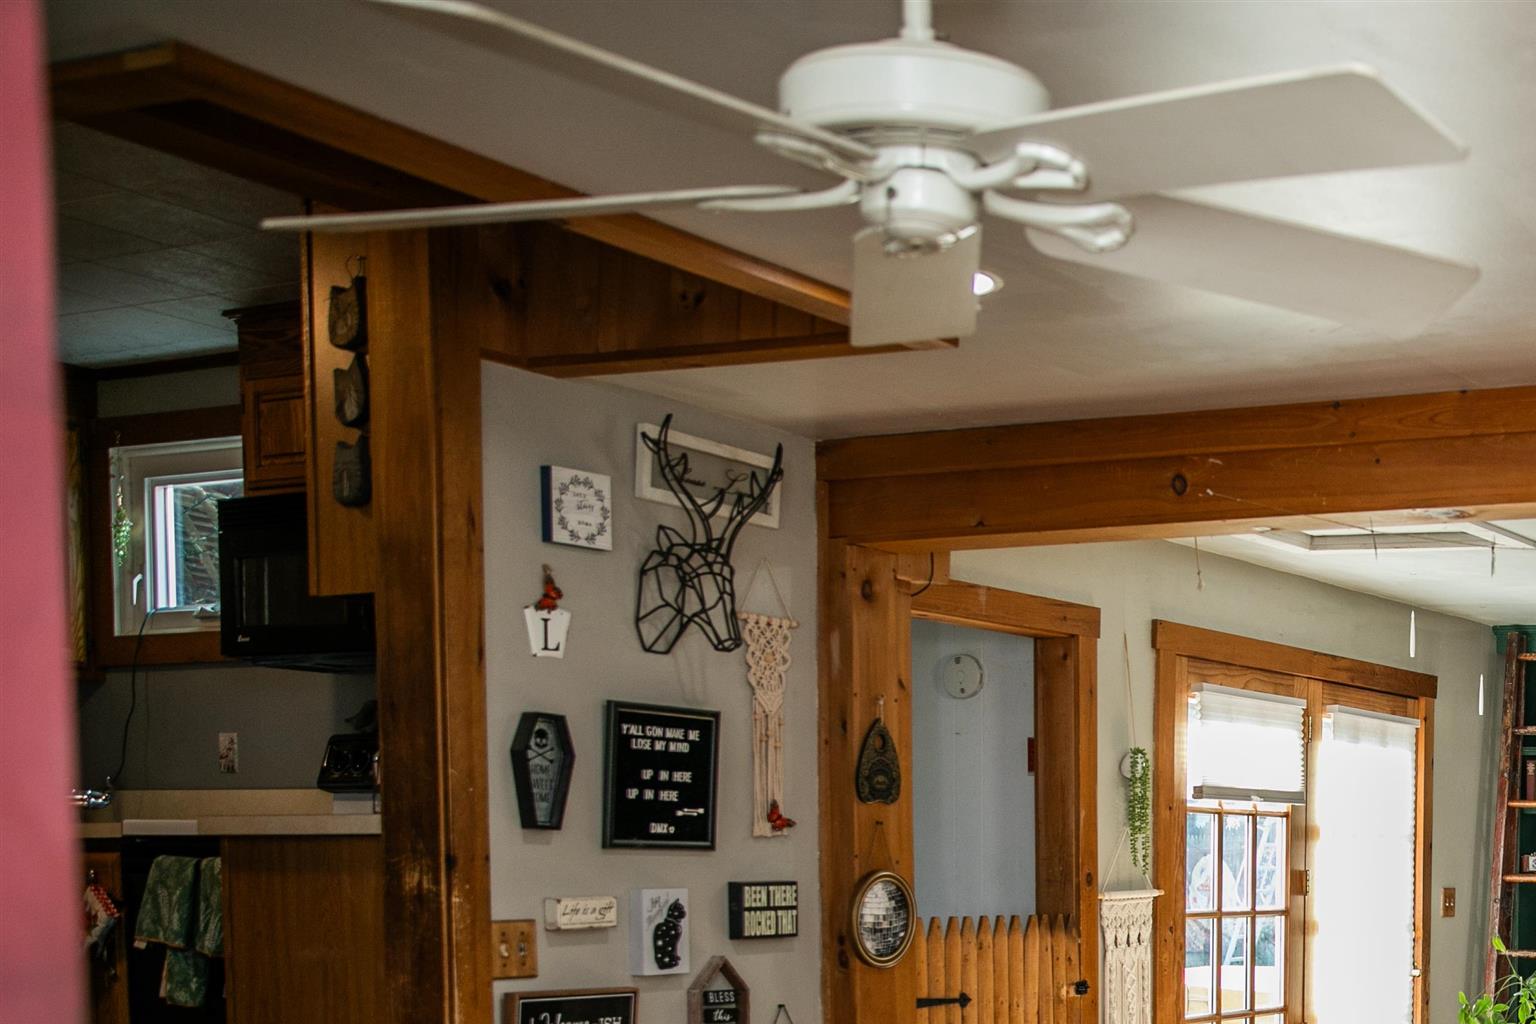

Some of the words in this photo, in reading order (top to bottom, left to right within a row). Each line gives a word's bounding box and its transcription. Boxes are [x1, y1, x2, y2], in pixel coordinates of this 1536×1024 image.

[541, 617, 561, 651] L
[645, 725, 664, 737] GON
[665, 728, 685, 740] MAKE
[687, 730, 700, 741] ME
[631, 738, 652, 750] LOSE
[654, 740, 666, 751] MY
[668, 741, 690, 753] MIND
[641, 769, 654, 780] UP
[659, 770, 669, 781] IN
[671, 771, 692, 783] HERE
[626, 788, 639, 799] UP
[643, 789, 655, 800] IN
[658, 790, 679, 801] HERE
[649, 822, 668, 834] DMX
[744, 886, 768, 908] BEEN
[769, 885, 797, 907] THERE
[562, 902, 580, 921] Life
[582, 906, 589, 914] is
[744, 910, 776, 937] ROCKED
[777, 909, 797, 935] THAT
[709, 991, 735, 1003] BLESS
[713, 1009, 732, 1021] this
